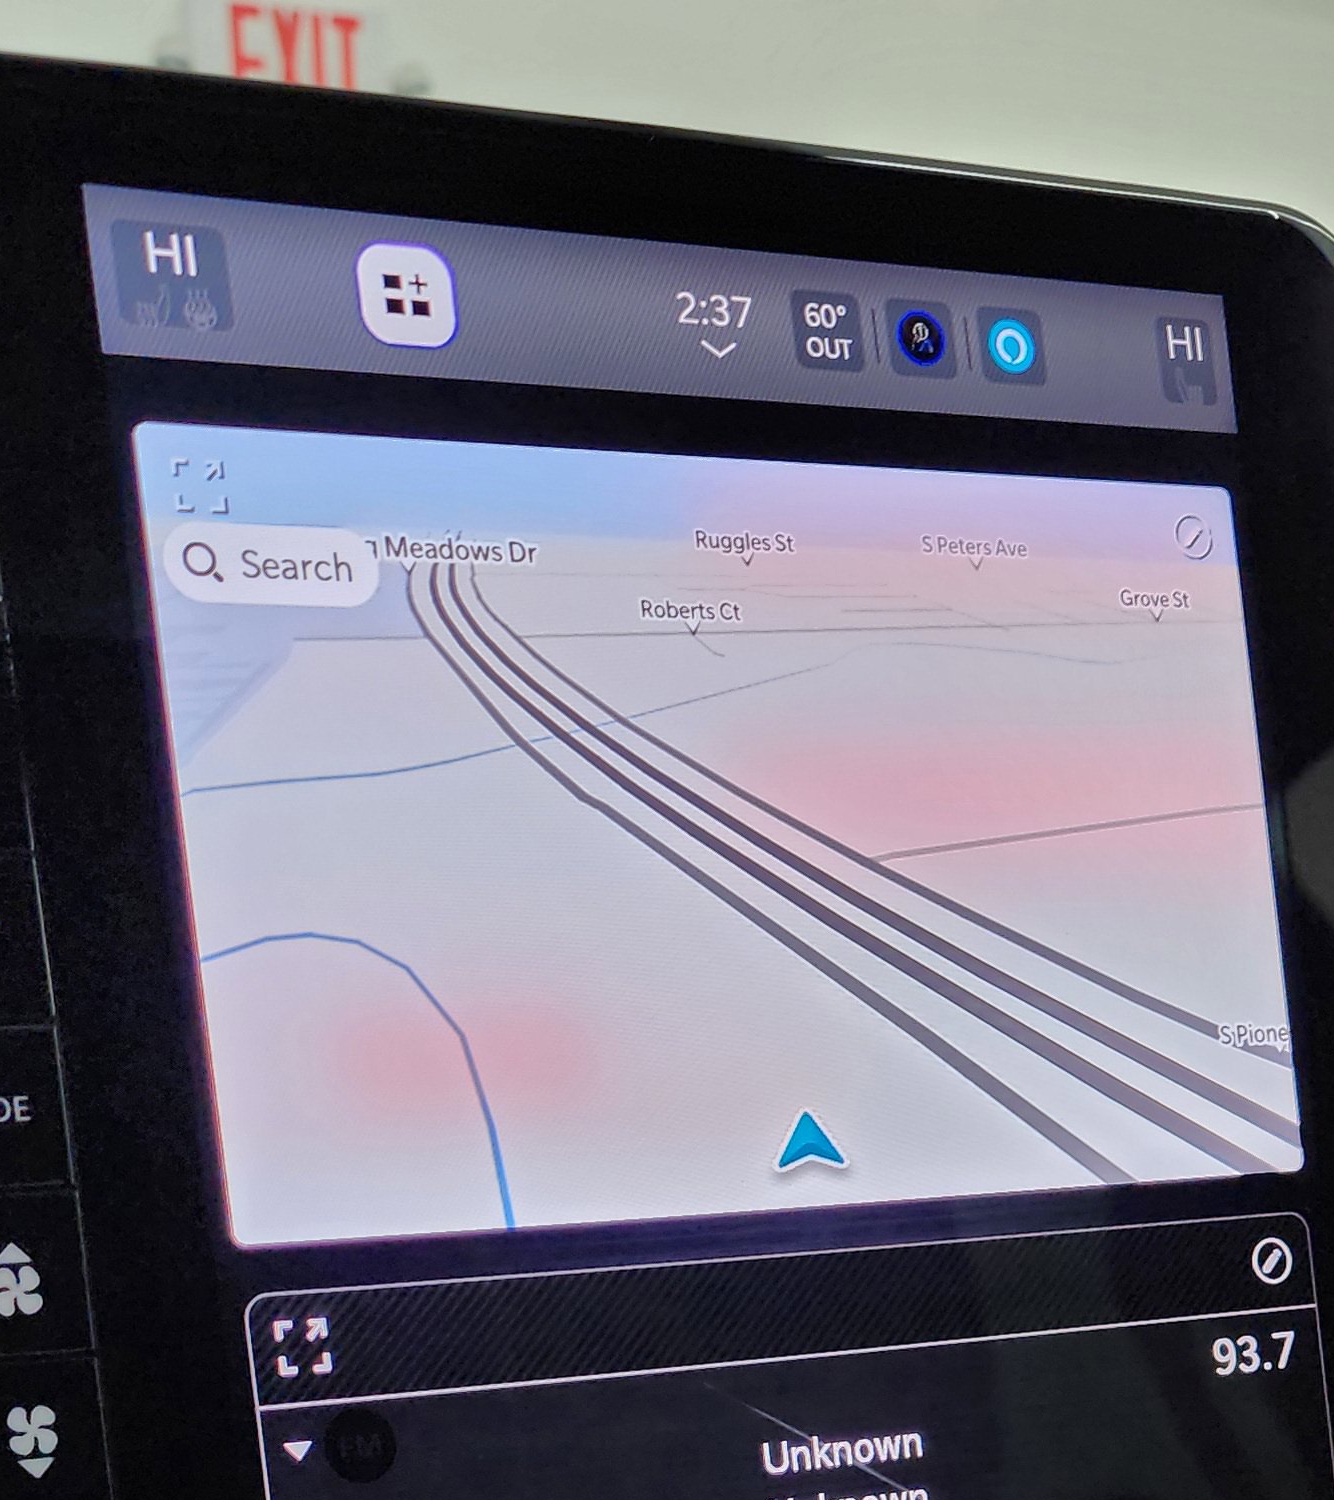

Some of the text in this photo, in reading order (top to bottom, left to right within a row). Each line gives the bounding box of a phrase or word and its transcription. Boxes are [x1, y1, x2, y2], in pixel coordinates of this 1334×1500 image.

[229, 4, 362, 90] EXIT
[142, 230, 198, 277] HI
[675, 292, 752, 328] 2:37
[804, 302, 846, 329] 60°
[806, 337, 852, 361] OUT
[1165, 324, 1204, 362] HI
[385, 534, 503, 562] Meadows
[509, 539, 537, 564] Dr
[695, 530, 795, 555] Ruggles St
[921, 536, 1028, 558] S Peters Ave
[241, 548, 353, 583] Search
[640, 600, 742, 622] Roberts Ct
[1120, 589, 1189, 609] Grove St
[1220, 1026, 1231, 1045] S
[1212, 1331, 1295, 1375] 93.7
[763, 1432, 923, 1475] Unknown
